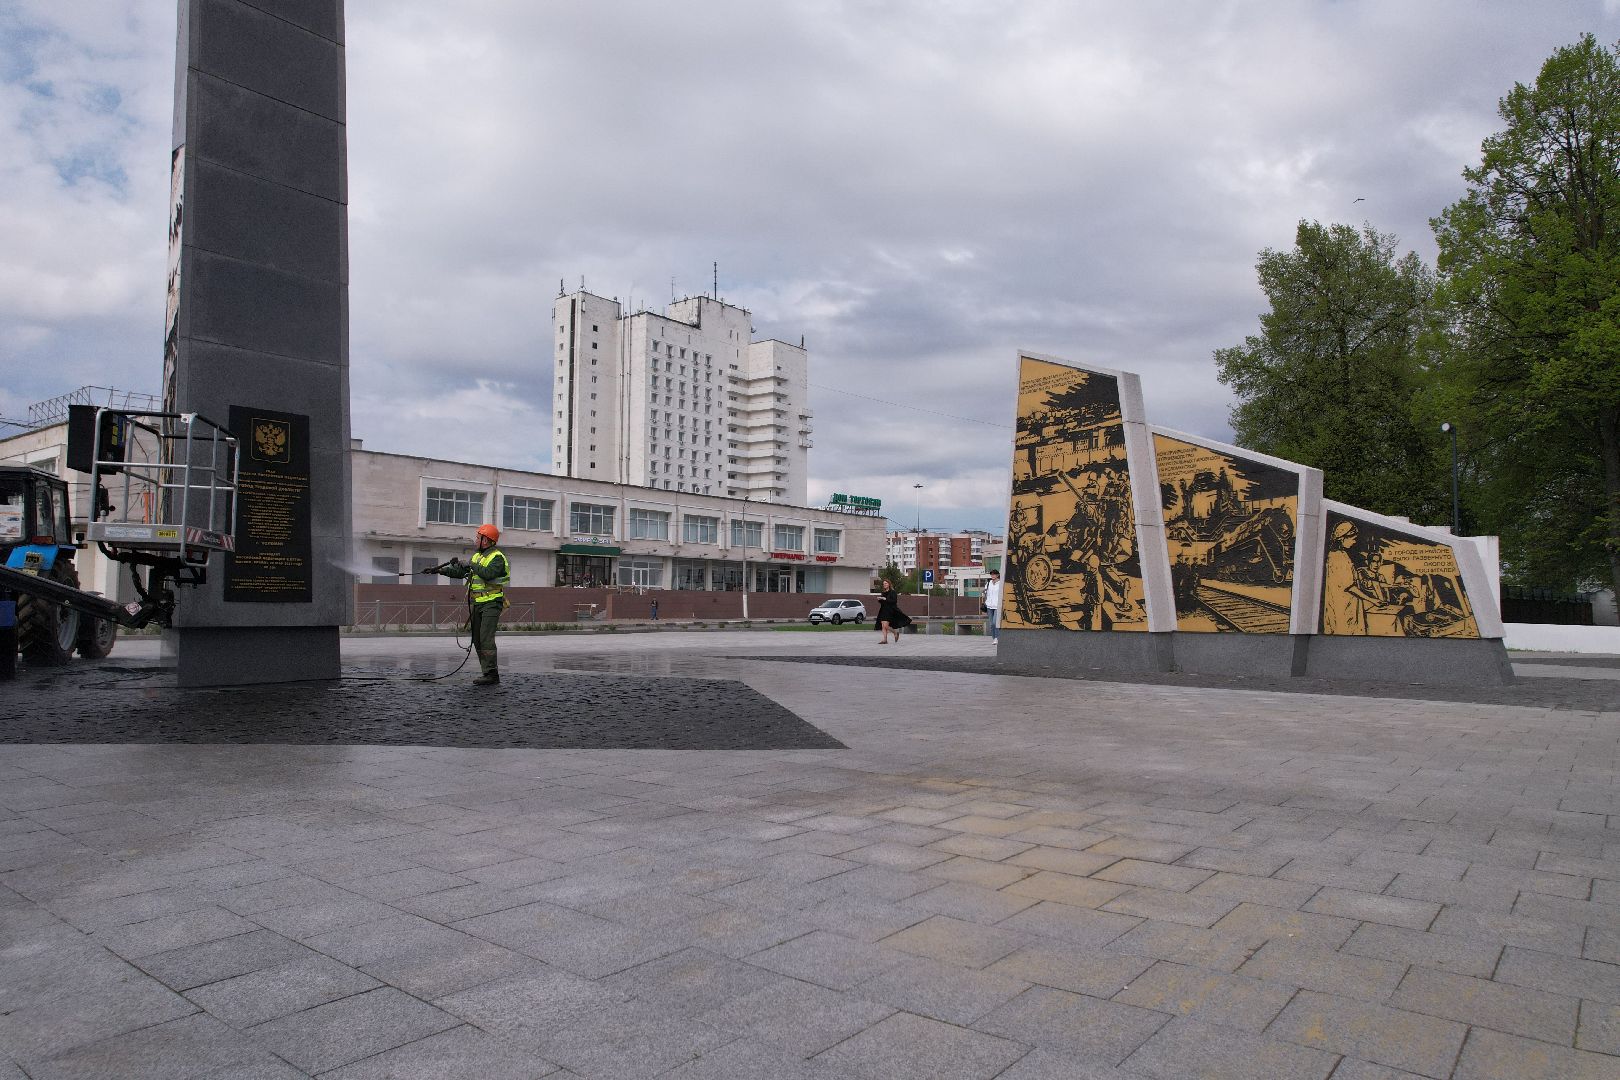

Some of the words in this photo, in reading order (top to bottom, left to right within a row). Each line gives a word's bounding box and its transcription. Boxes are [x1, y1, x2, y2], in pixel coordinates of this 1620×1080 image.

[833, 493, 847, 503] ДОМ
[849, 495, 881, 507] ТОРГОВЛИ
[925, 571, 932, 581] P
